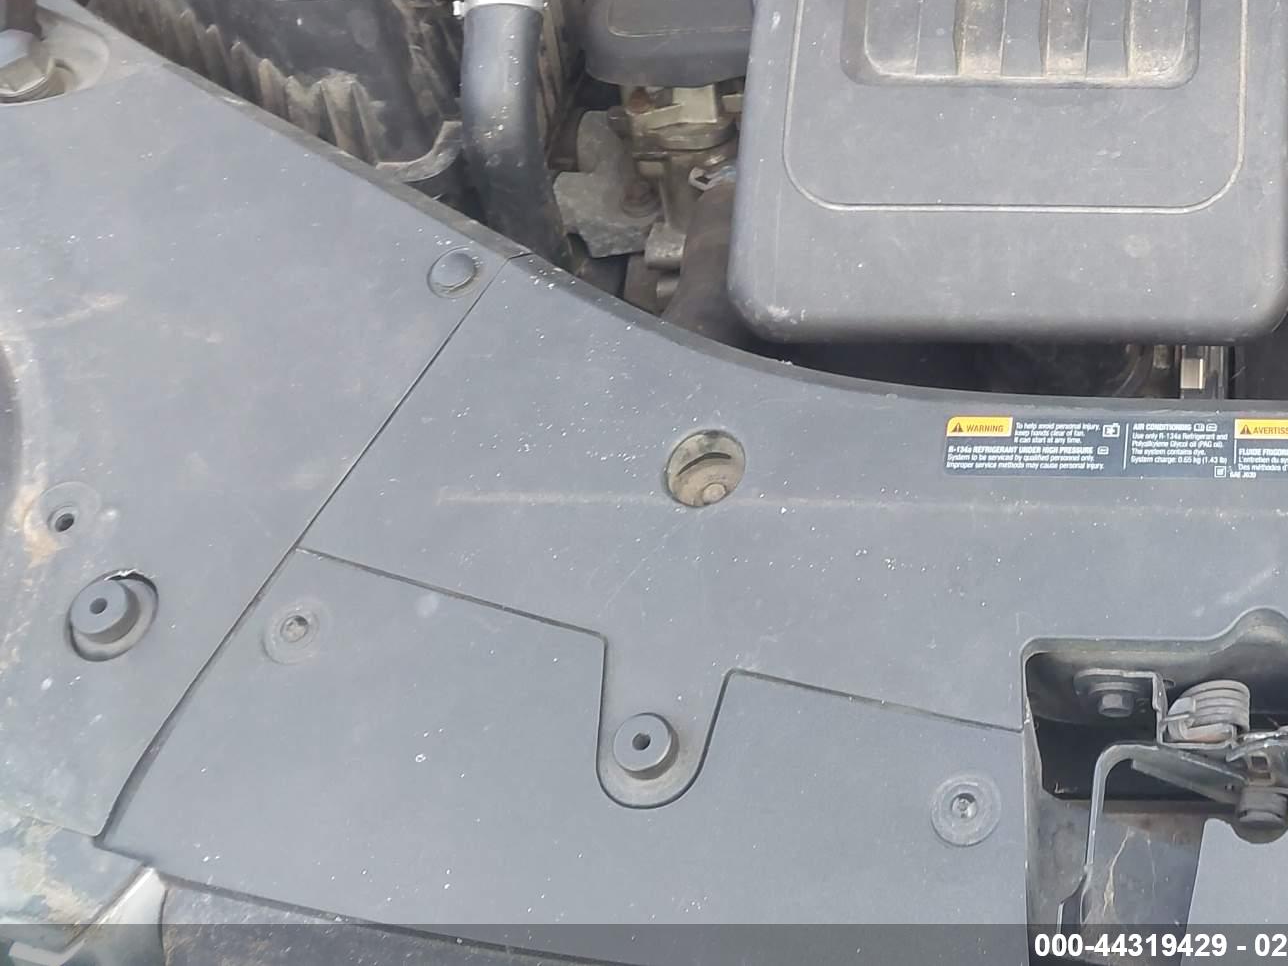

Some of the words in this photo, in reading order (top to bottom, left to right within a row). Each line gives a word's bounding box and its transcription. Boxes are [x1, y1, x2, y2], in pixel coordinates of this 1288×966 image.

[966, 425, 1004, 434] WARNING
[1146, 423, 1192, 431] CONDITIONING
[1060, 446, 1093, 454] PRESSURE
